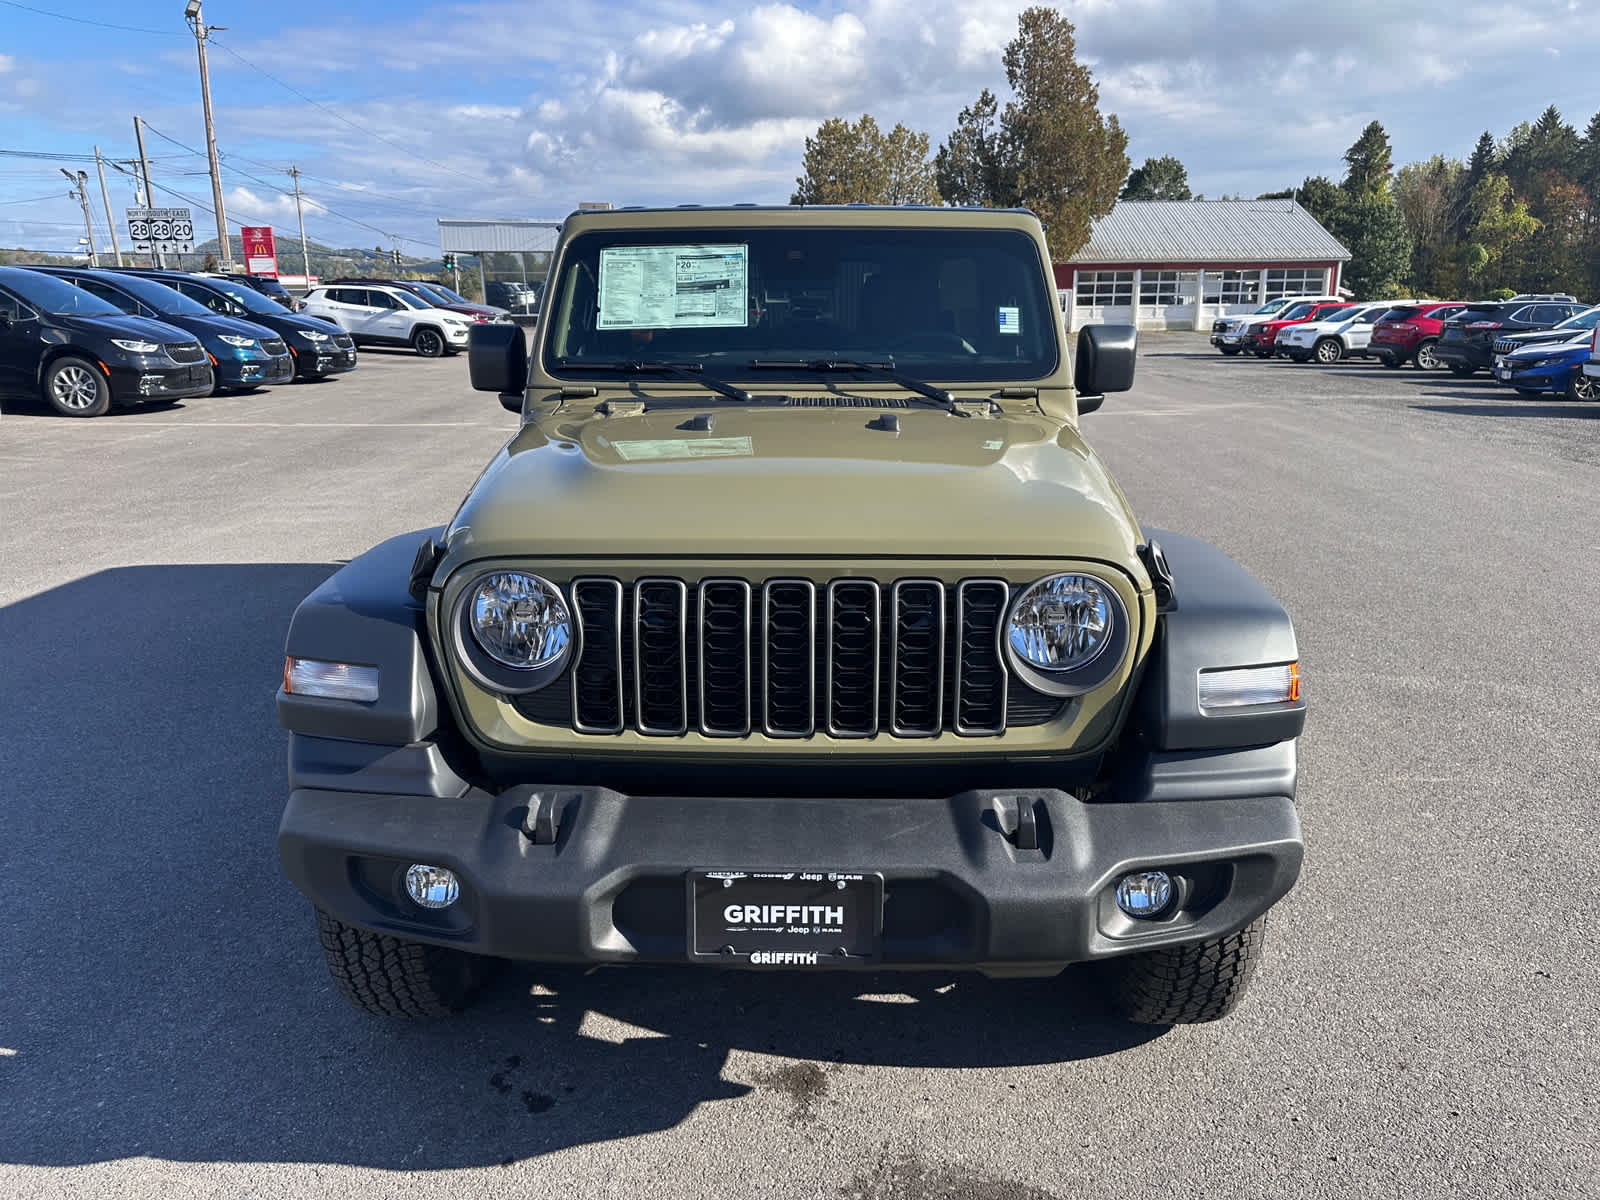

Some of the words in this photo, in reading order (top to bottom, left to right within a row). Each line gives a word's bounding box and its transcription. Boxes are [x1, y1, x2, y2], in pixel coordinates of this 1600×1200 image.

[131, 224, 148, 236] 28
[152, 224, 169, 236] 28
[174, 224, 191, 236] 20
[800, 872, 823, 881] Jeep
[724, 905, 843, 924] GRIFFITH
[787, 925, 810, 934] Jeep
[750, 951, 818, 965] GRIFFITH
